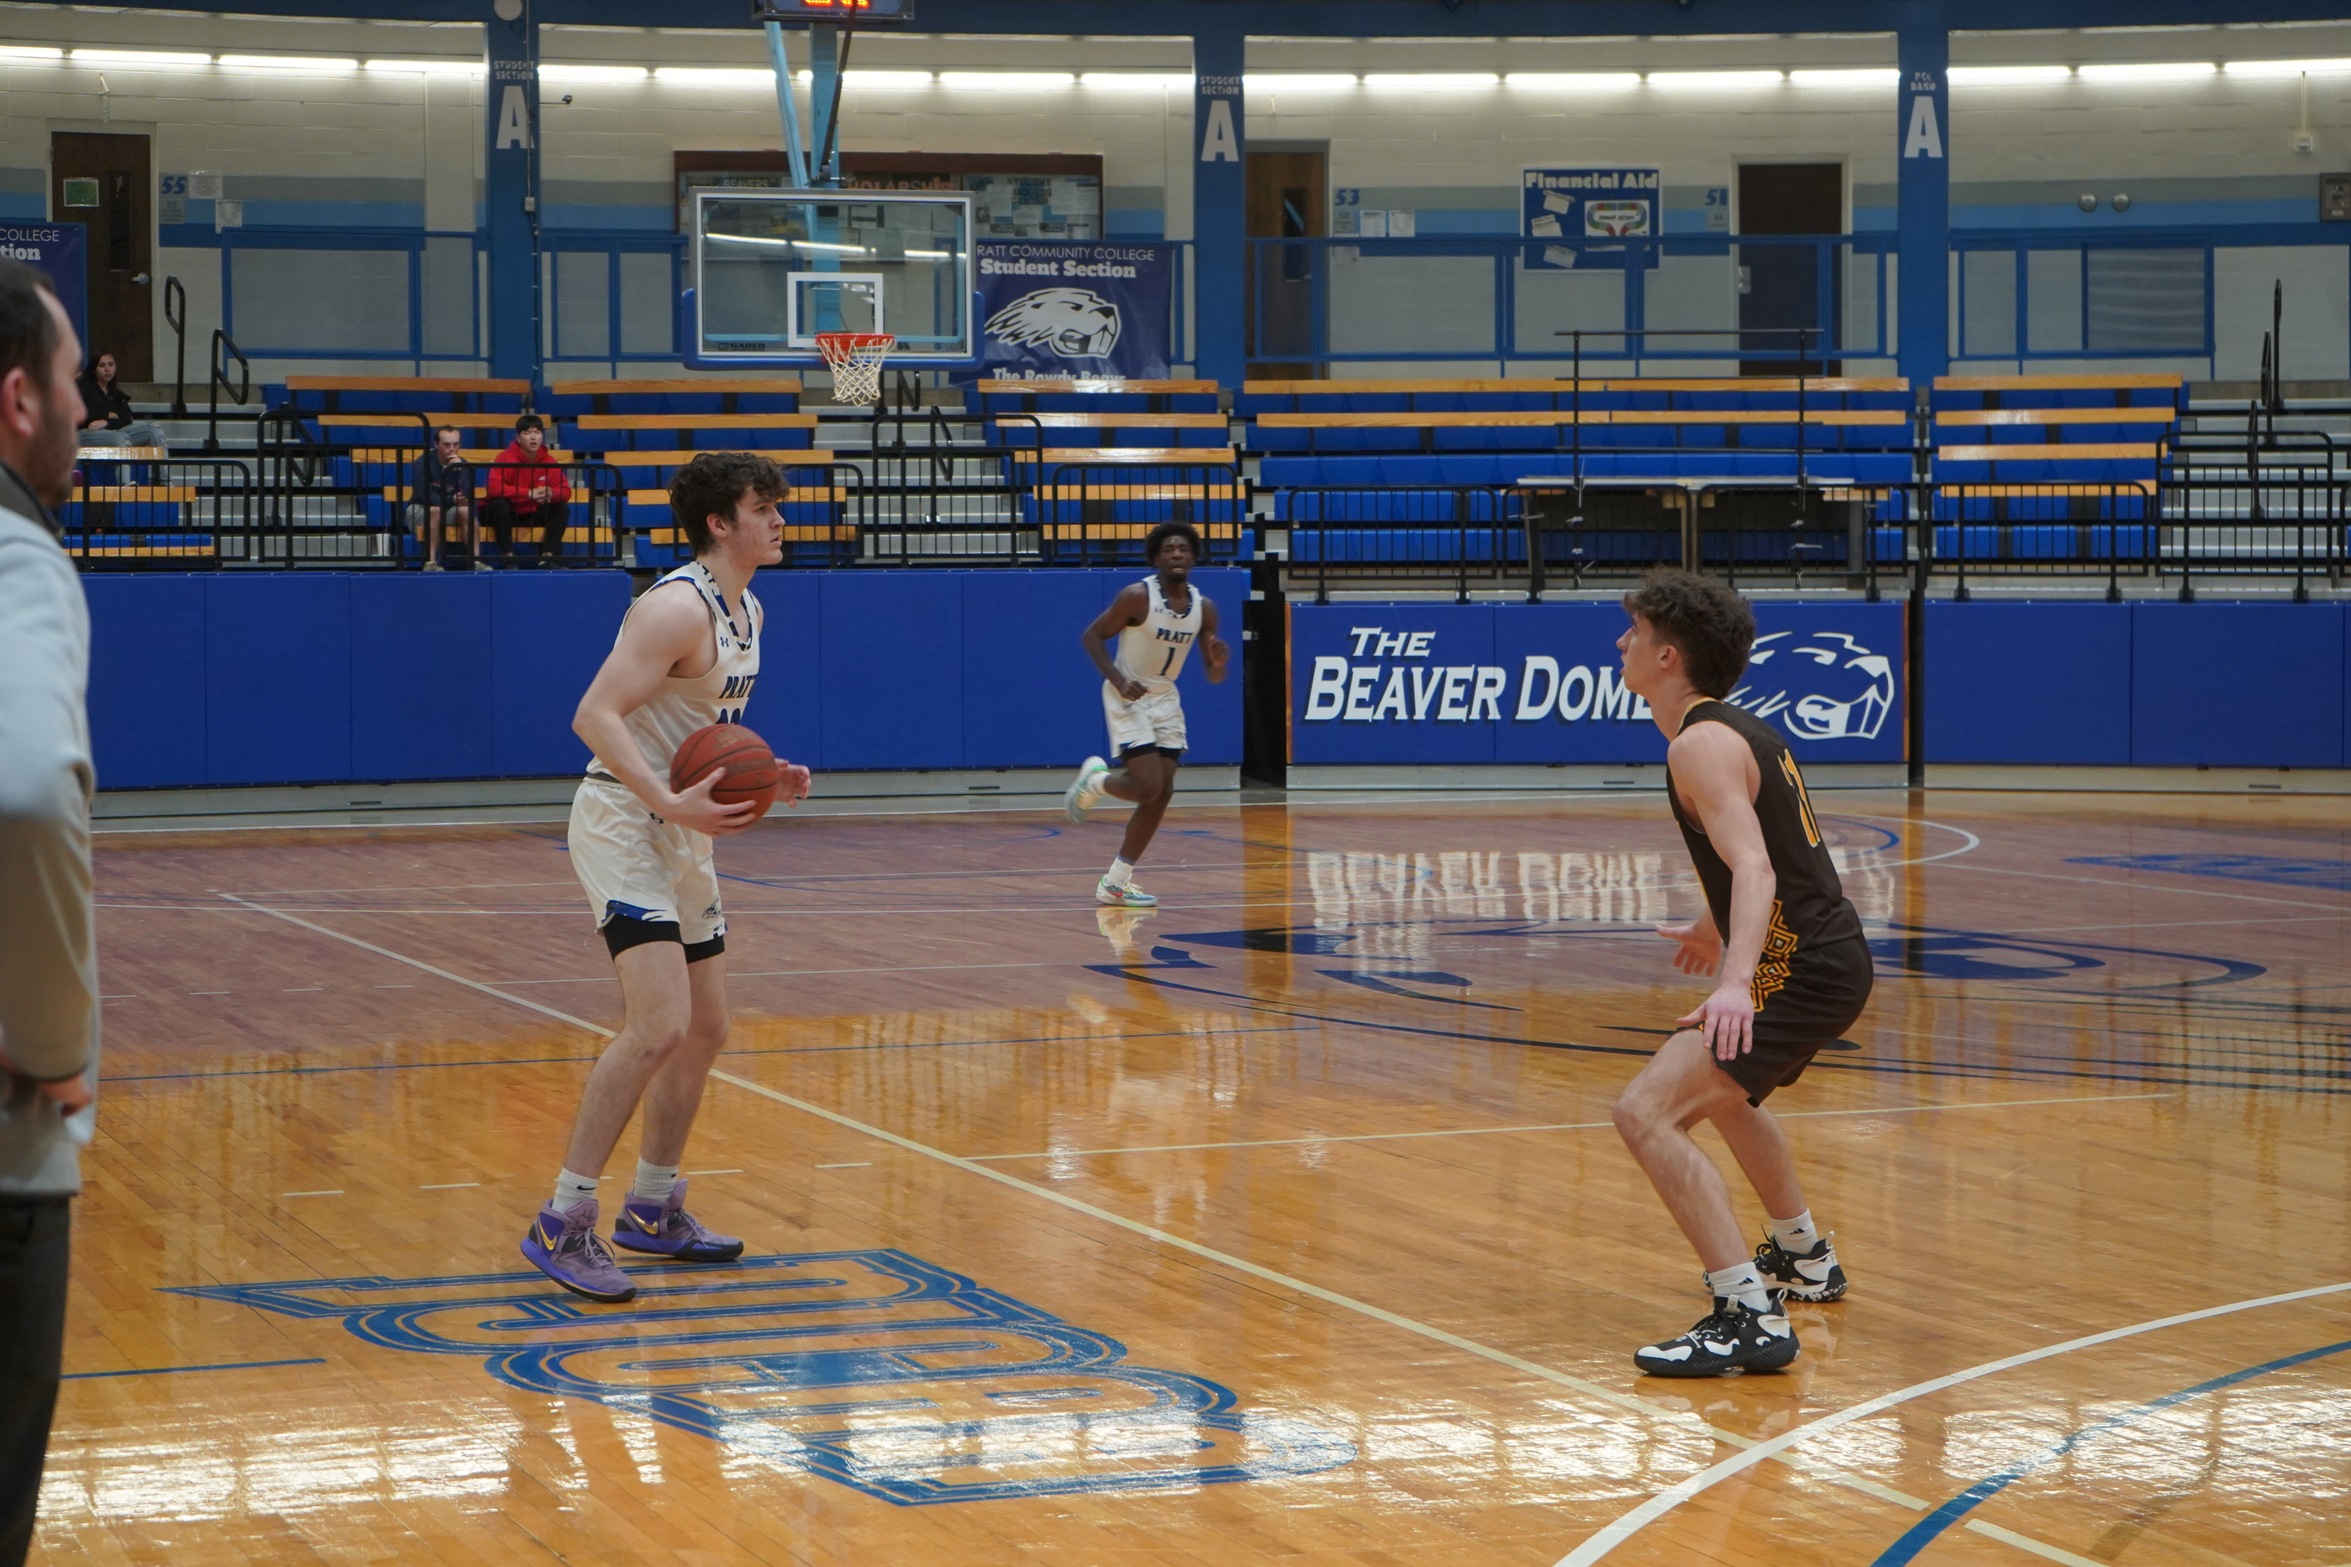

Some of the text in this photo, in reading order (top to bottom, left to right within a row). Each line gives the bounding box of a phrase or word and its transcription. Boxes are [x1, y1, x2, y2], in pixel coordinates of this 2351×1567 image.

[1201, 86, 1239, 95] SECTION
[495, 85, 535, 149] A
[1904, 95, 1943, 158] A
[1201, 100, 1239, 162] A
[160, 176, 186, 195] 55
[1525, 172, 1658, 189] Financial Aid
[1334, 189, 1360, 206] 53
[1704, 188, 1728, 206] 51
[977, 245, 1155, 261] RATT COMMUNITY COLLEGE
[980, 258, 1136, 278] Student Section
[1155, 628, 1193, 644] PRATT
[1351, 627, 1436, 657] THE
[1158, 647, 1176, 676] 1
[1304, 656, 1507, 722] BEAVER
